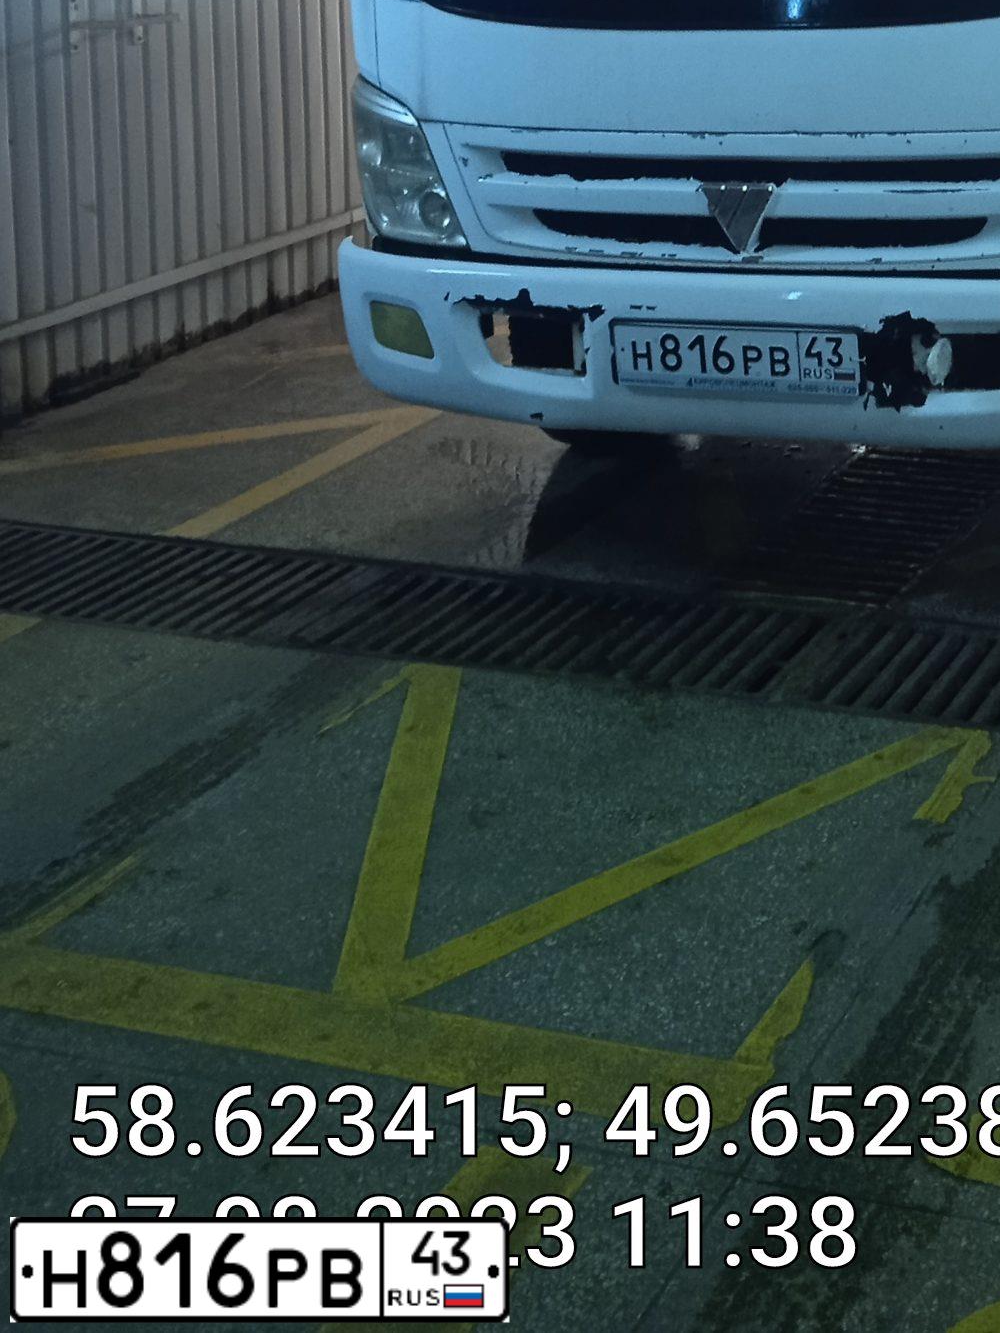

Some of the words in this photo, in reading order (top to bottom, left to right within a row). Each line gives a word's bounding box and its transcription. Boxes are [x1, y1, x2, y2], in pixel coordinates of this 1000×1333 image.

[631, 333, 791, 377] Н816РВ
[804, 336, 844, 367] 43
[803, 367, 833, 379] RUS
